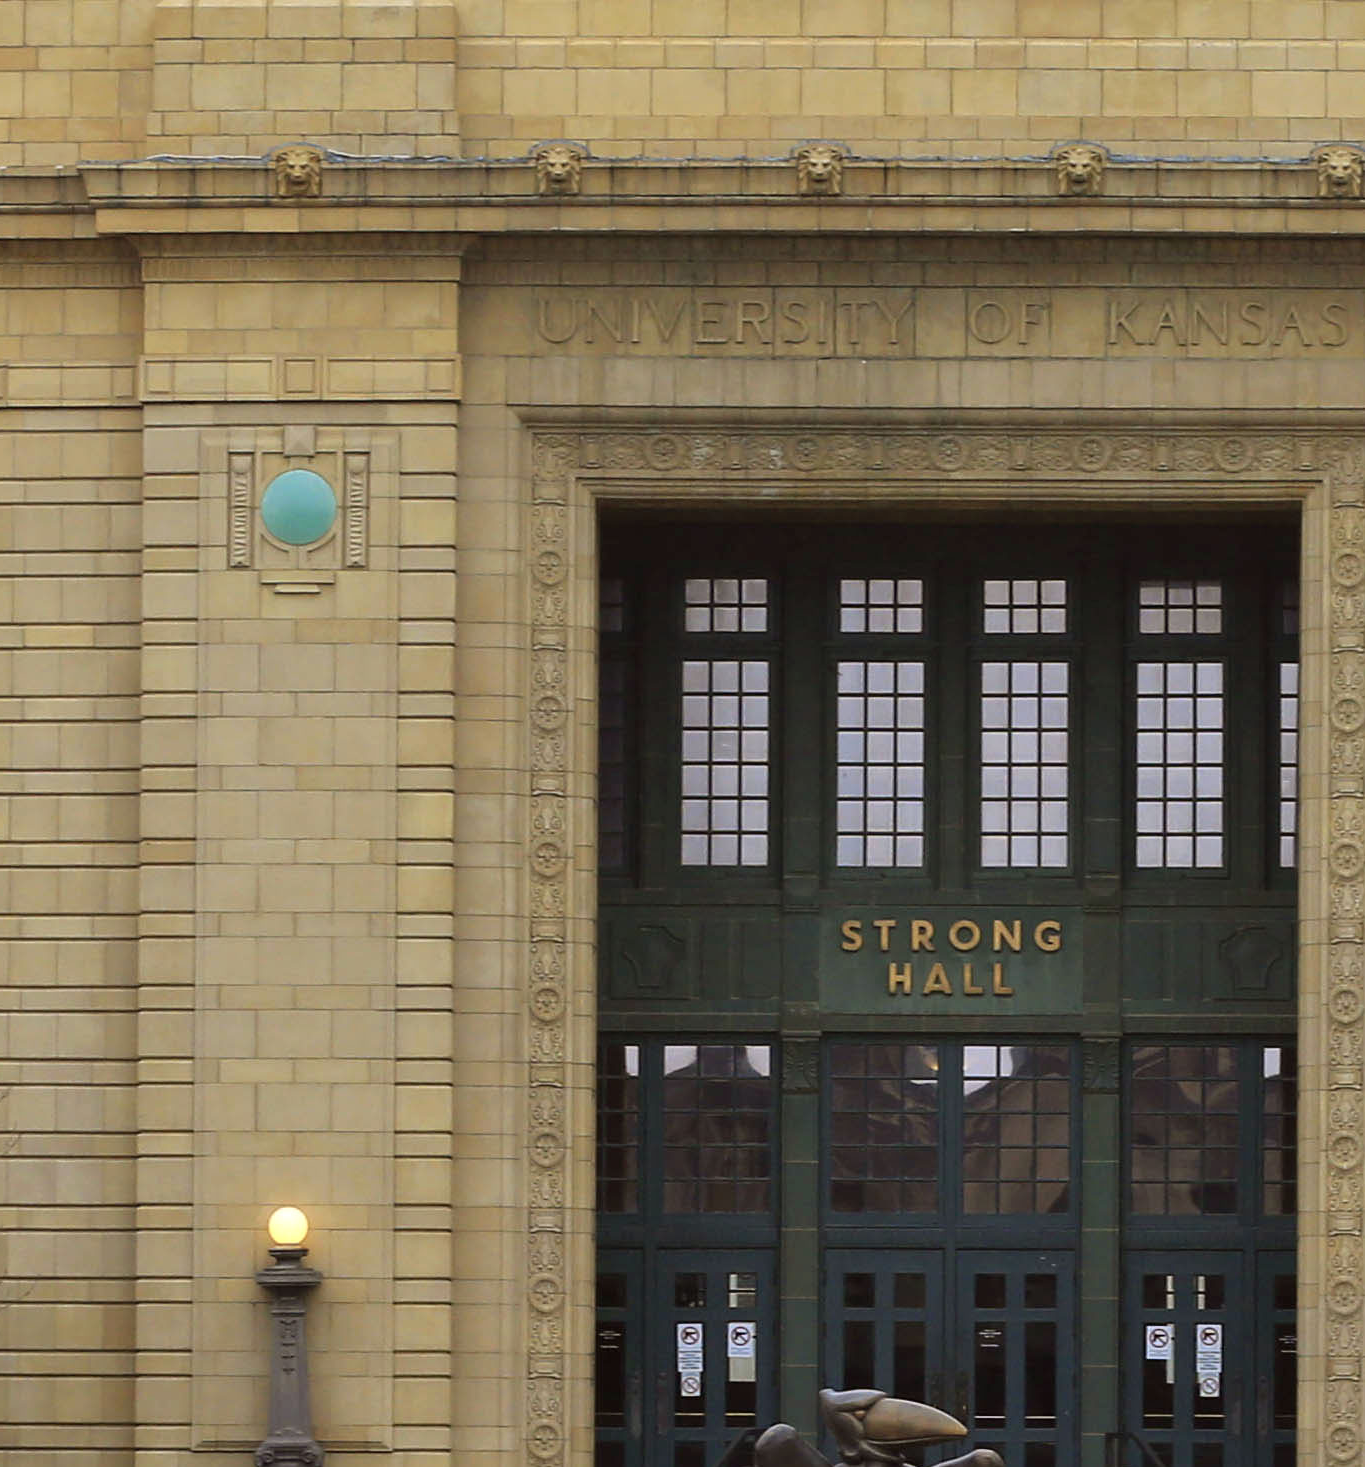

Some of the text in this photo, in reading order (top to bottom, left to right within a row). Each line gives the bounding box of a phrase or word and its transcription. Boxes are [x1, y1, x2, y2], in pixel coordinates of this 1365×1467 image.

[536, 299, 1349, 347] UNIVERSITY OF KANSAS
[841, 919, 1062, 952] STRONG
[888, 962, 1014, 995] HALL
